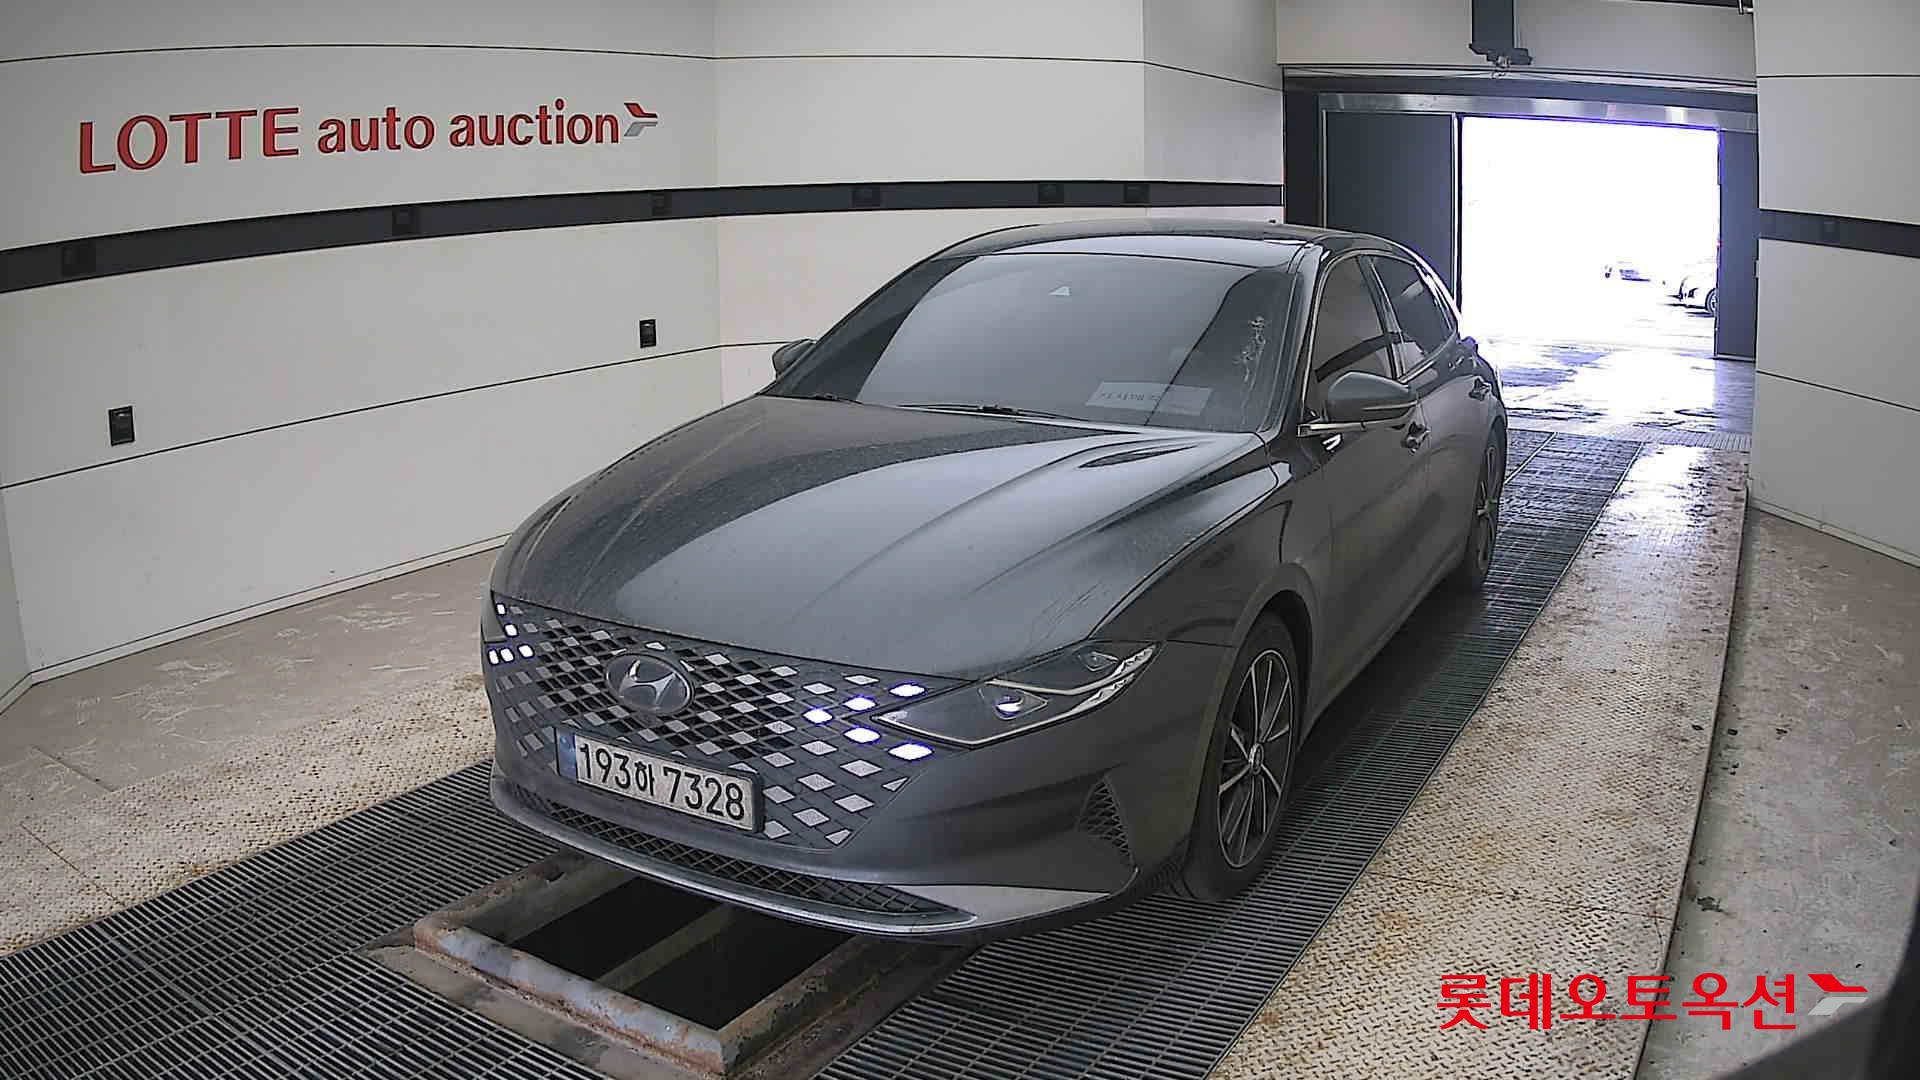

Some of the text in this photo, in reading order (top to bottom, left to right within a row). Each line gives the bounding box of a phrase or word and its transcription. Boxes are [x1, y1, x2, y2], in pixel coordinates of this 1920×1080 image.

[79, 98, 621, 174] LOTTE auto auction
[579, 743, 746, 821] 193하 7328
